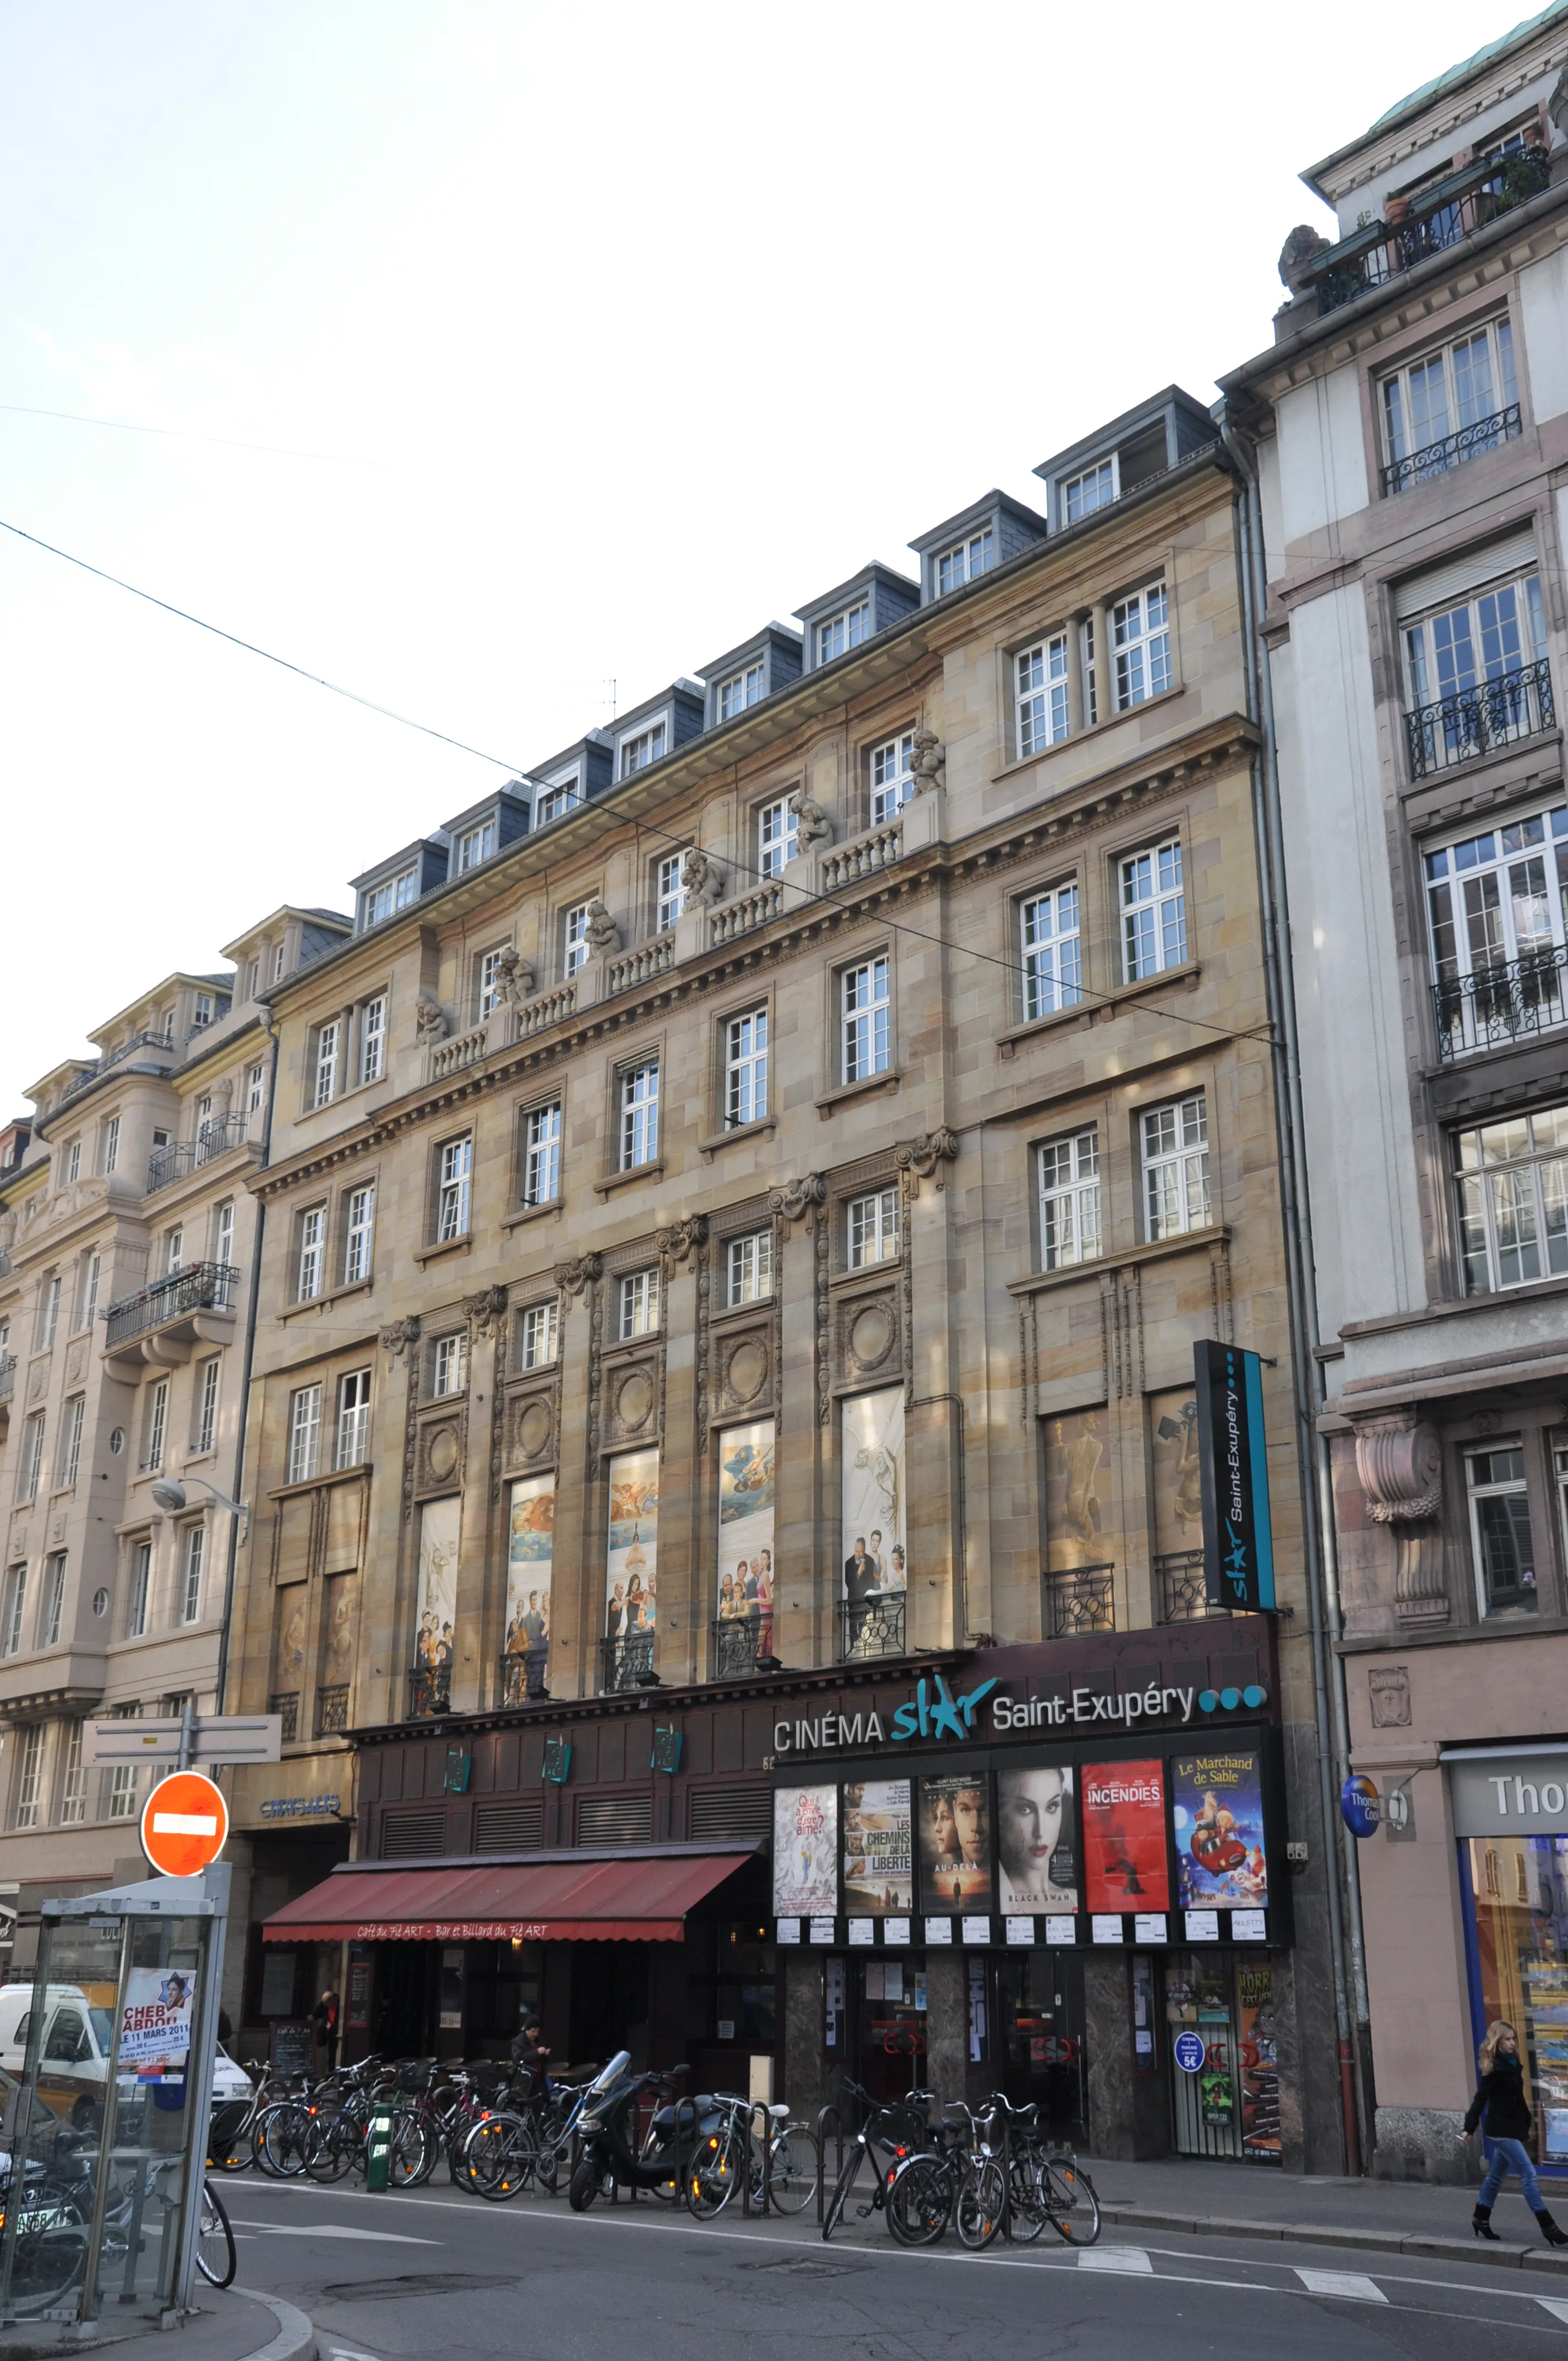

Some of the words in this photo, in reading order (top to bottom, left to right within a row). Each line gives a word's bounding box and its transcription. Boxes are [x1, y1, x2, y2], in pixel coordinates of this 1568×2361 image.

[1226, 1390, 1243, 1522] Saint-Exupéry
[774, 1710, 884, 1752] CINÉMA
[1179, 1762, 1194, 1776] Le
[1196, 1755, 1253, 1771] Marchand
[1194, 1772, 1207, 1785] de
[1210, 1770, 1238, 1783] Sable
[799, 1795, 814, 1808] Qui
[1088, 1786, 1160, 1804] INCENDIES
[1489, 1776, 1568, 1814] Tho
[803, 1807, 820, 1815] envie
[897, 1820, 910, 1830] LES
[867, 1831, 910, 1846] CHEMINS
[890, 1846, 899, 1854] DE
[901, 1845, 910, 1854] LA
[358, 1924, 376, 1937] Café
[377, 1924, 386, 1936] du
[402, 1925, 424, 1936] ART
[435, 1925, 451, 1936] Bar
[453, 1926, 460, 1936] et
[462, 1923, 493, 1936] Billard
[494, 1924, 506, 1936] du
[524, 1925, 549, 1936] ART
[1233, 1919, 1264, 1927] ARRIETTY
[1239, 1971, 1272, 1995] HORR
[124, 2005, 165, 2019] CHEB
[120, 2034, 129, 2044] LE
[131, 2033, 140, 2042] 11
[144, 2028, 166, 2040] MARS
[169, 2024, 188, 2035] 2011
[1184, 2055, 1196, 2067] 5€
